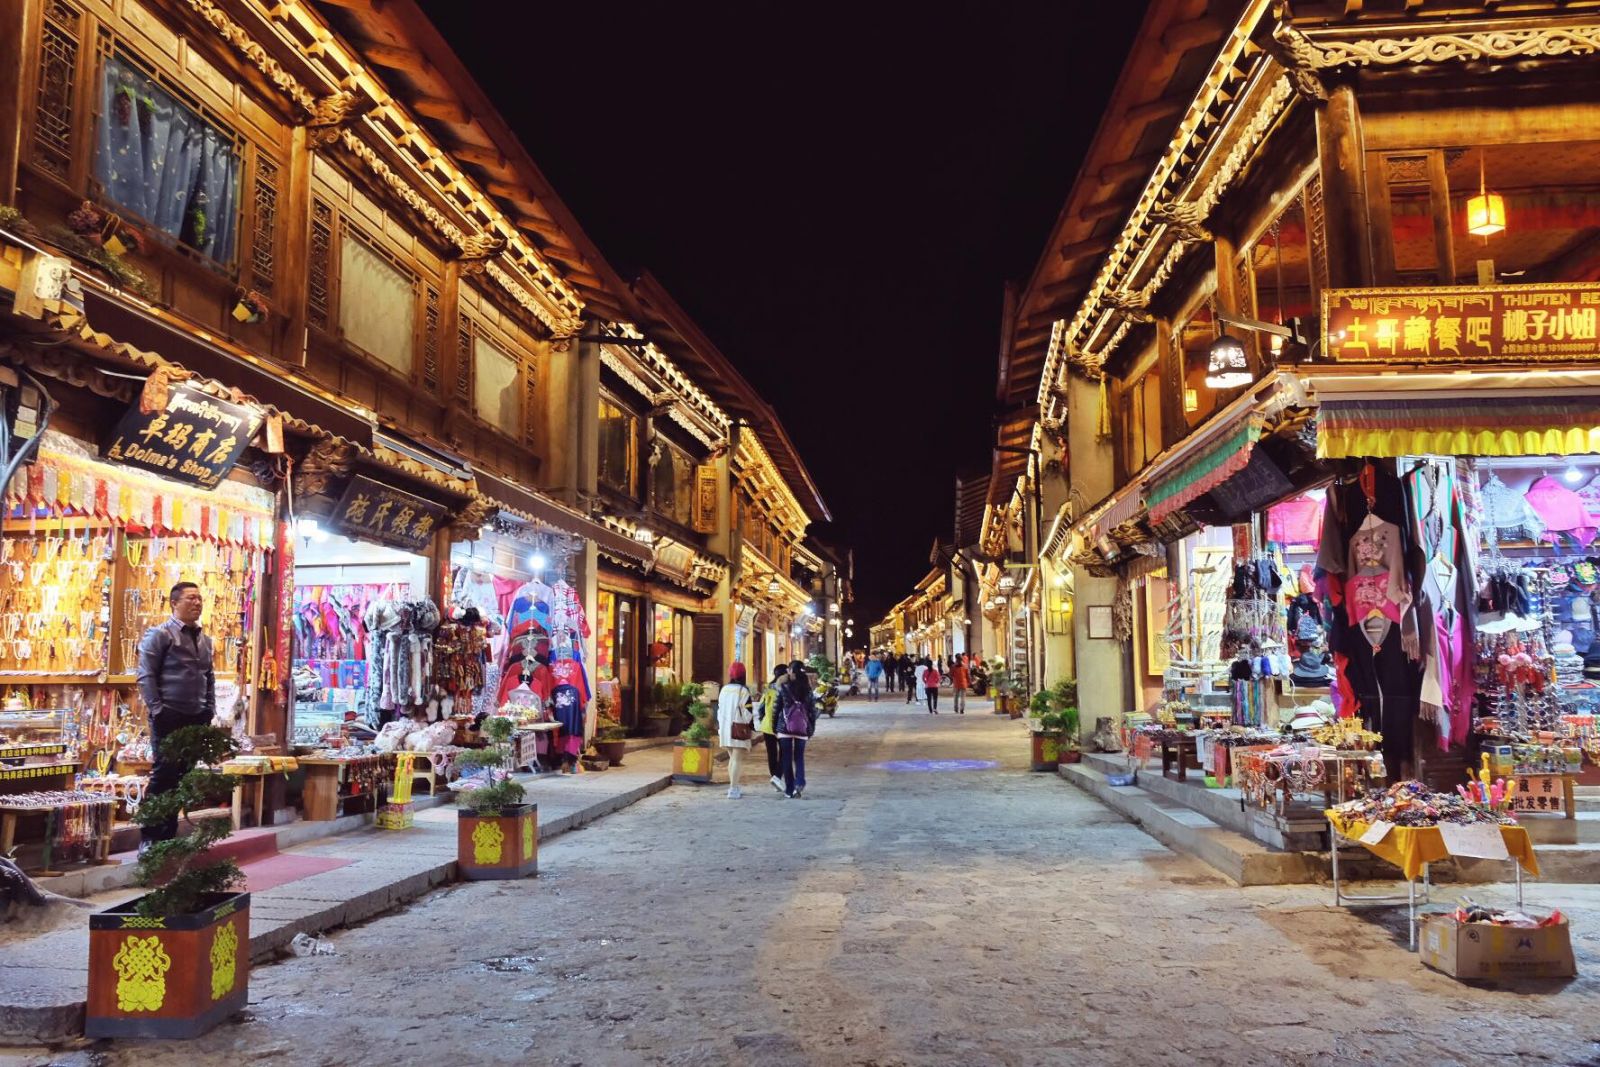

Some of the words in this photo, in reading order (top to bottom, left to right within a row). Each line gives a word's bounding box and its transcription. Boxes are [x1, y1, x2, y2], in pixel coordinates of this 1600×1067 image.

[1501, 293, 1571, 306] THUPTEN
[1343, 315, 1493, 357] 土哥藏餐吧
[139, 413, 237, 465] 卓玛商店
[124, 442, 178, 470] Dolma's
[179, 459, 213, 482] Shop
[1514, 796, 1560, 810] 批发零售
